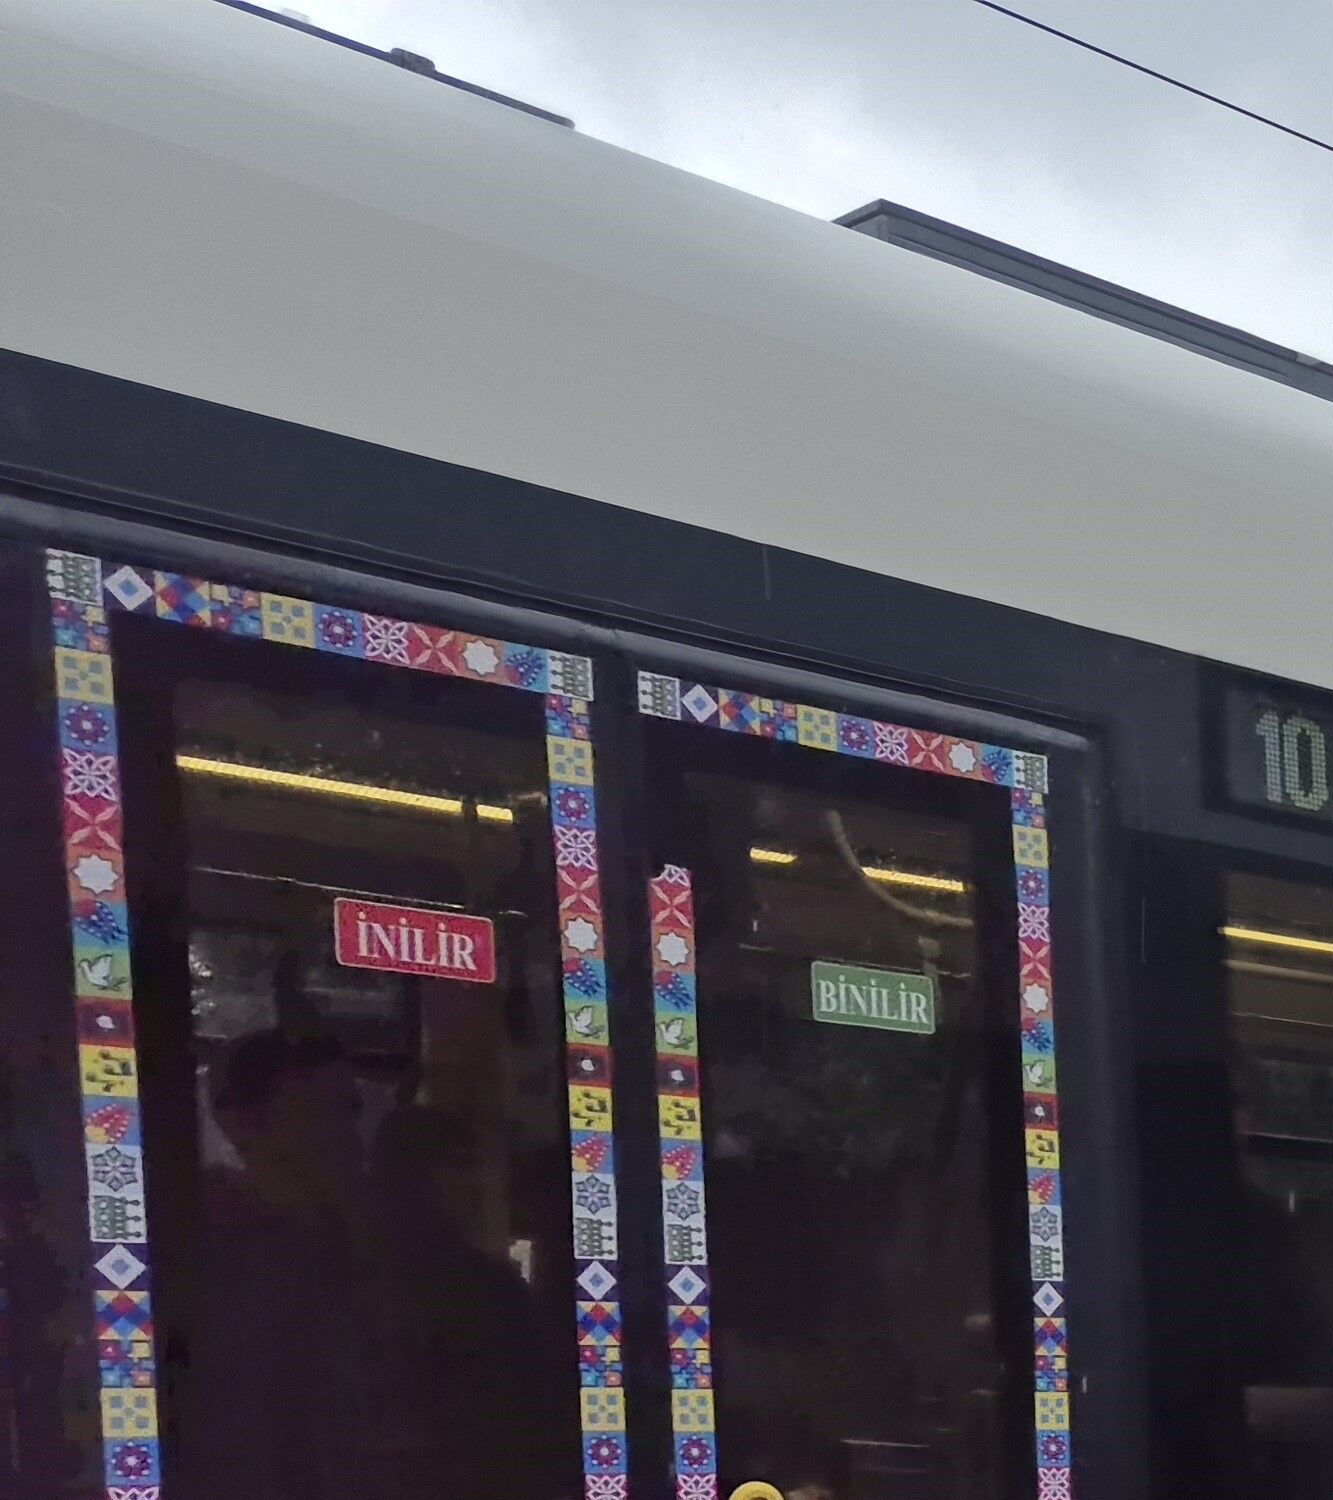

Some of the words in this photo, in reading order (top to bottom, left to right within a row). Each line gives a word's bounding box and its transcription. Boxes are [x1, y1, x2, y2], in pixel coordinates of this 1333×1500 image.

[1255, 711, 1330, 812] 10
[356, 910, 477, 972] İNİLİR
[817, 974, 929, 1025] BİNİLİR
